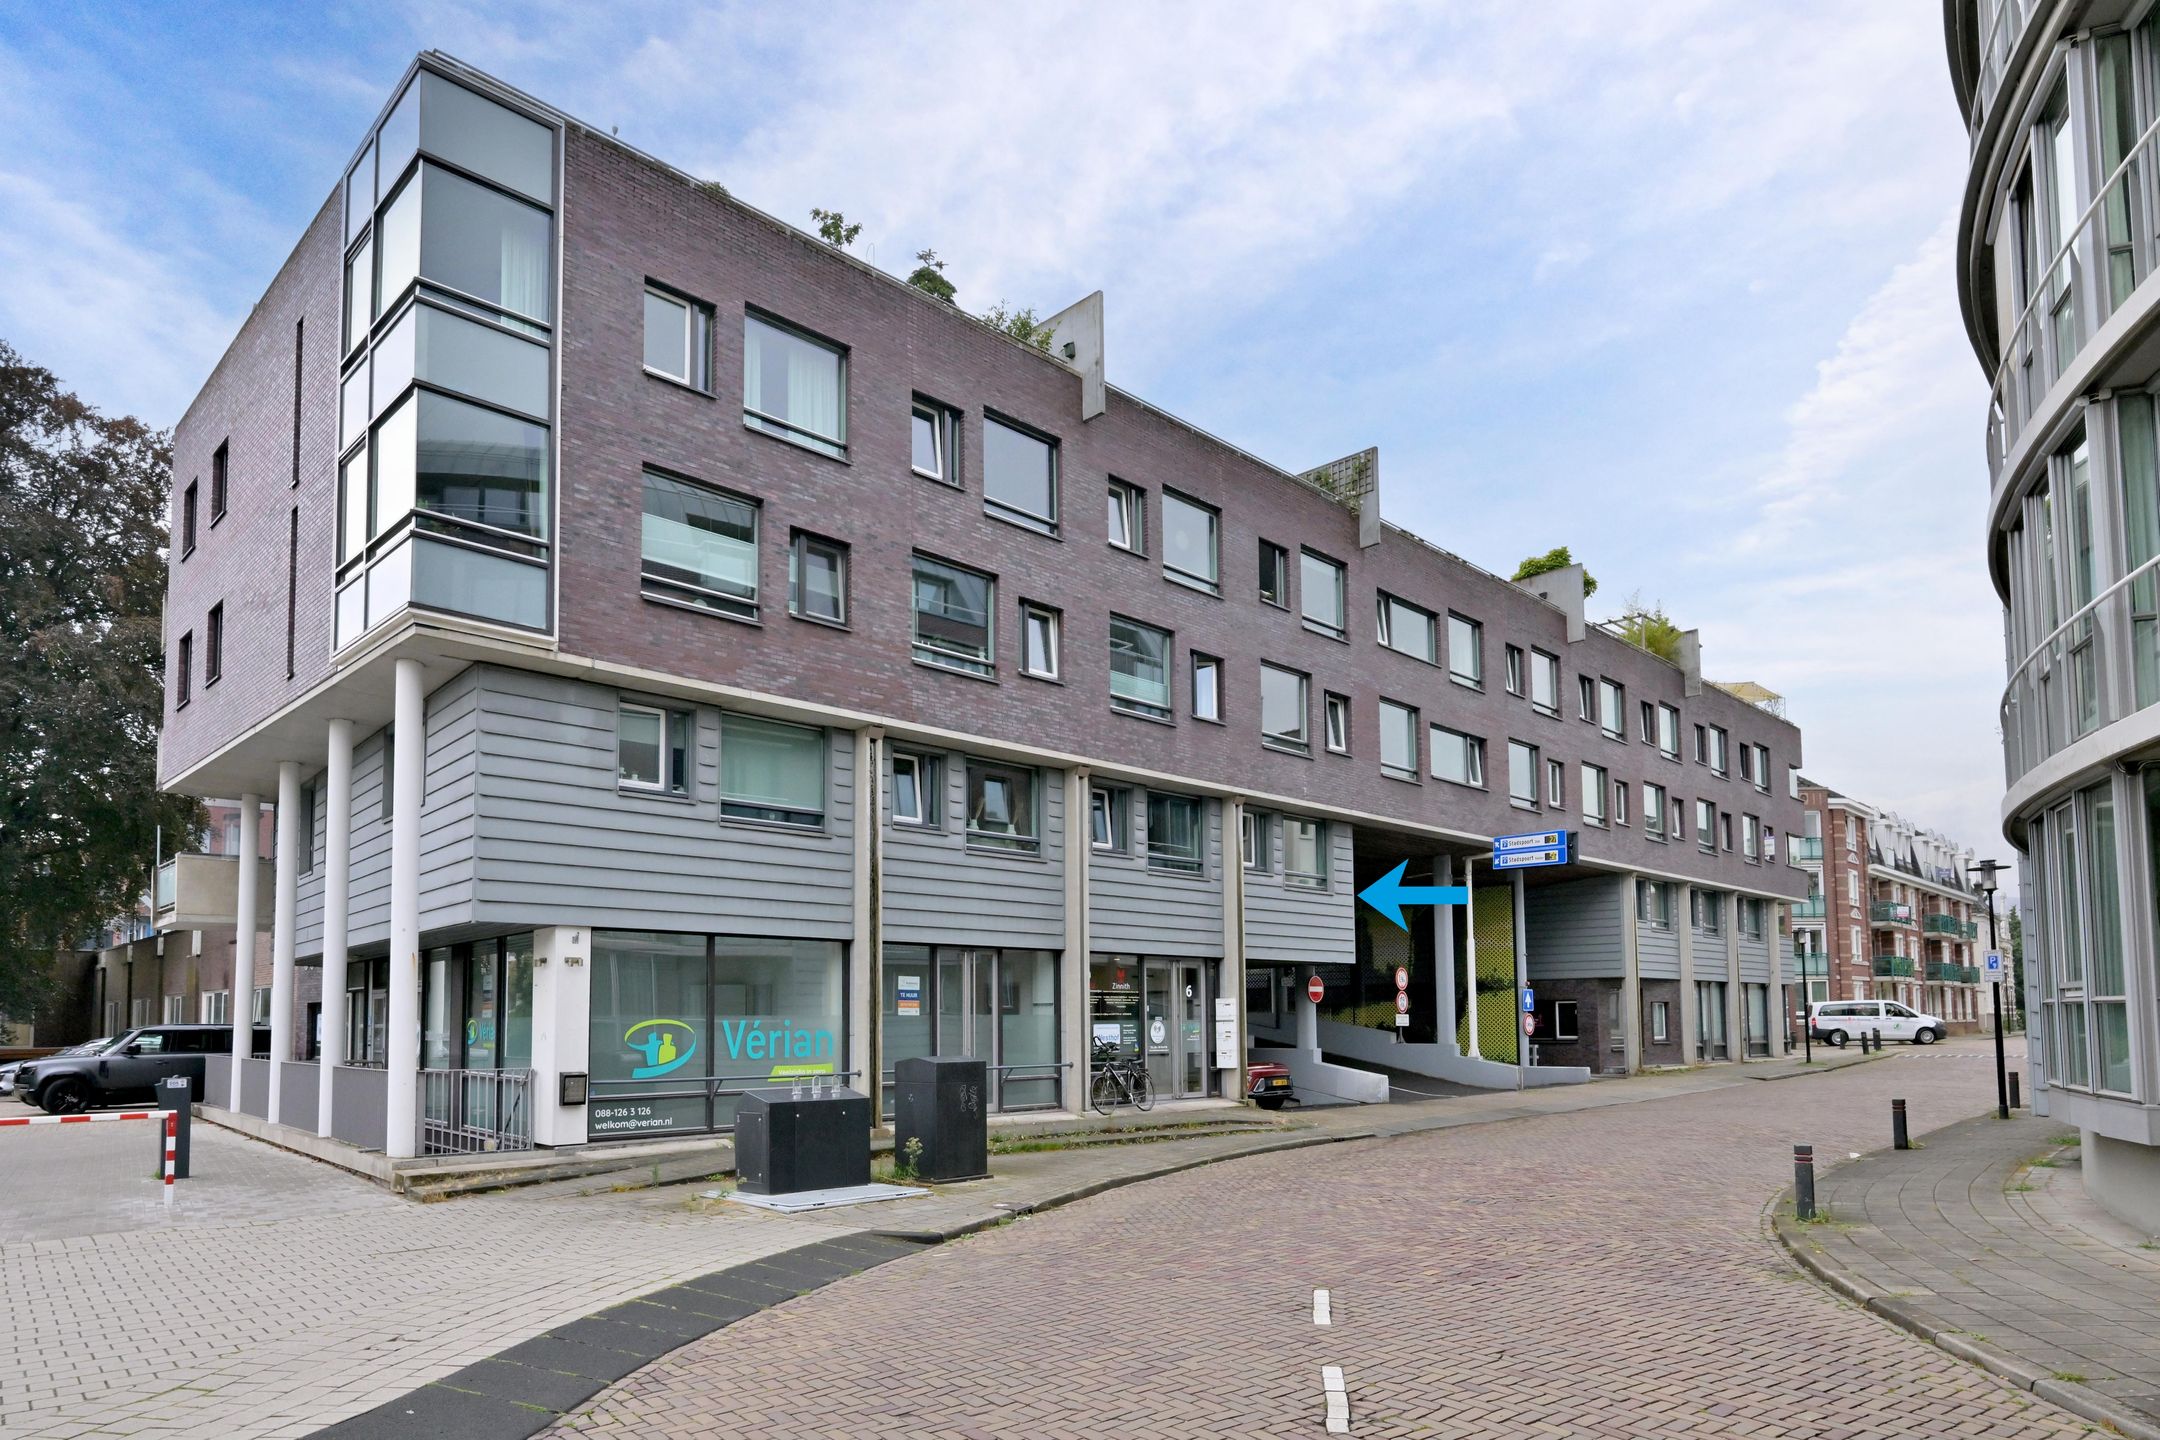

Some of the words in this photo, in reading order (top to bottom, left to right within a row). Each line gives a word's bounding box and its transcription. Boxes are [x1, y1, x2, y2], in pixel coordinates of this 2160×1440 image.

[1185, 985, 1193, 998] 6
[722, 1019, 834, 1060] Vérian
[595, 1108, 628, 1118] 088-126
[630, 1107, 635, 1116] 3
[638, 1106, 651, 1116] 126
[595, 1117, 673, 1130] welkom@verian.nl
